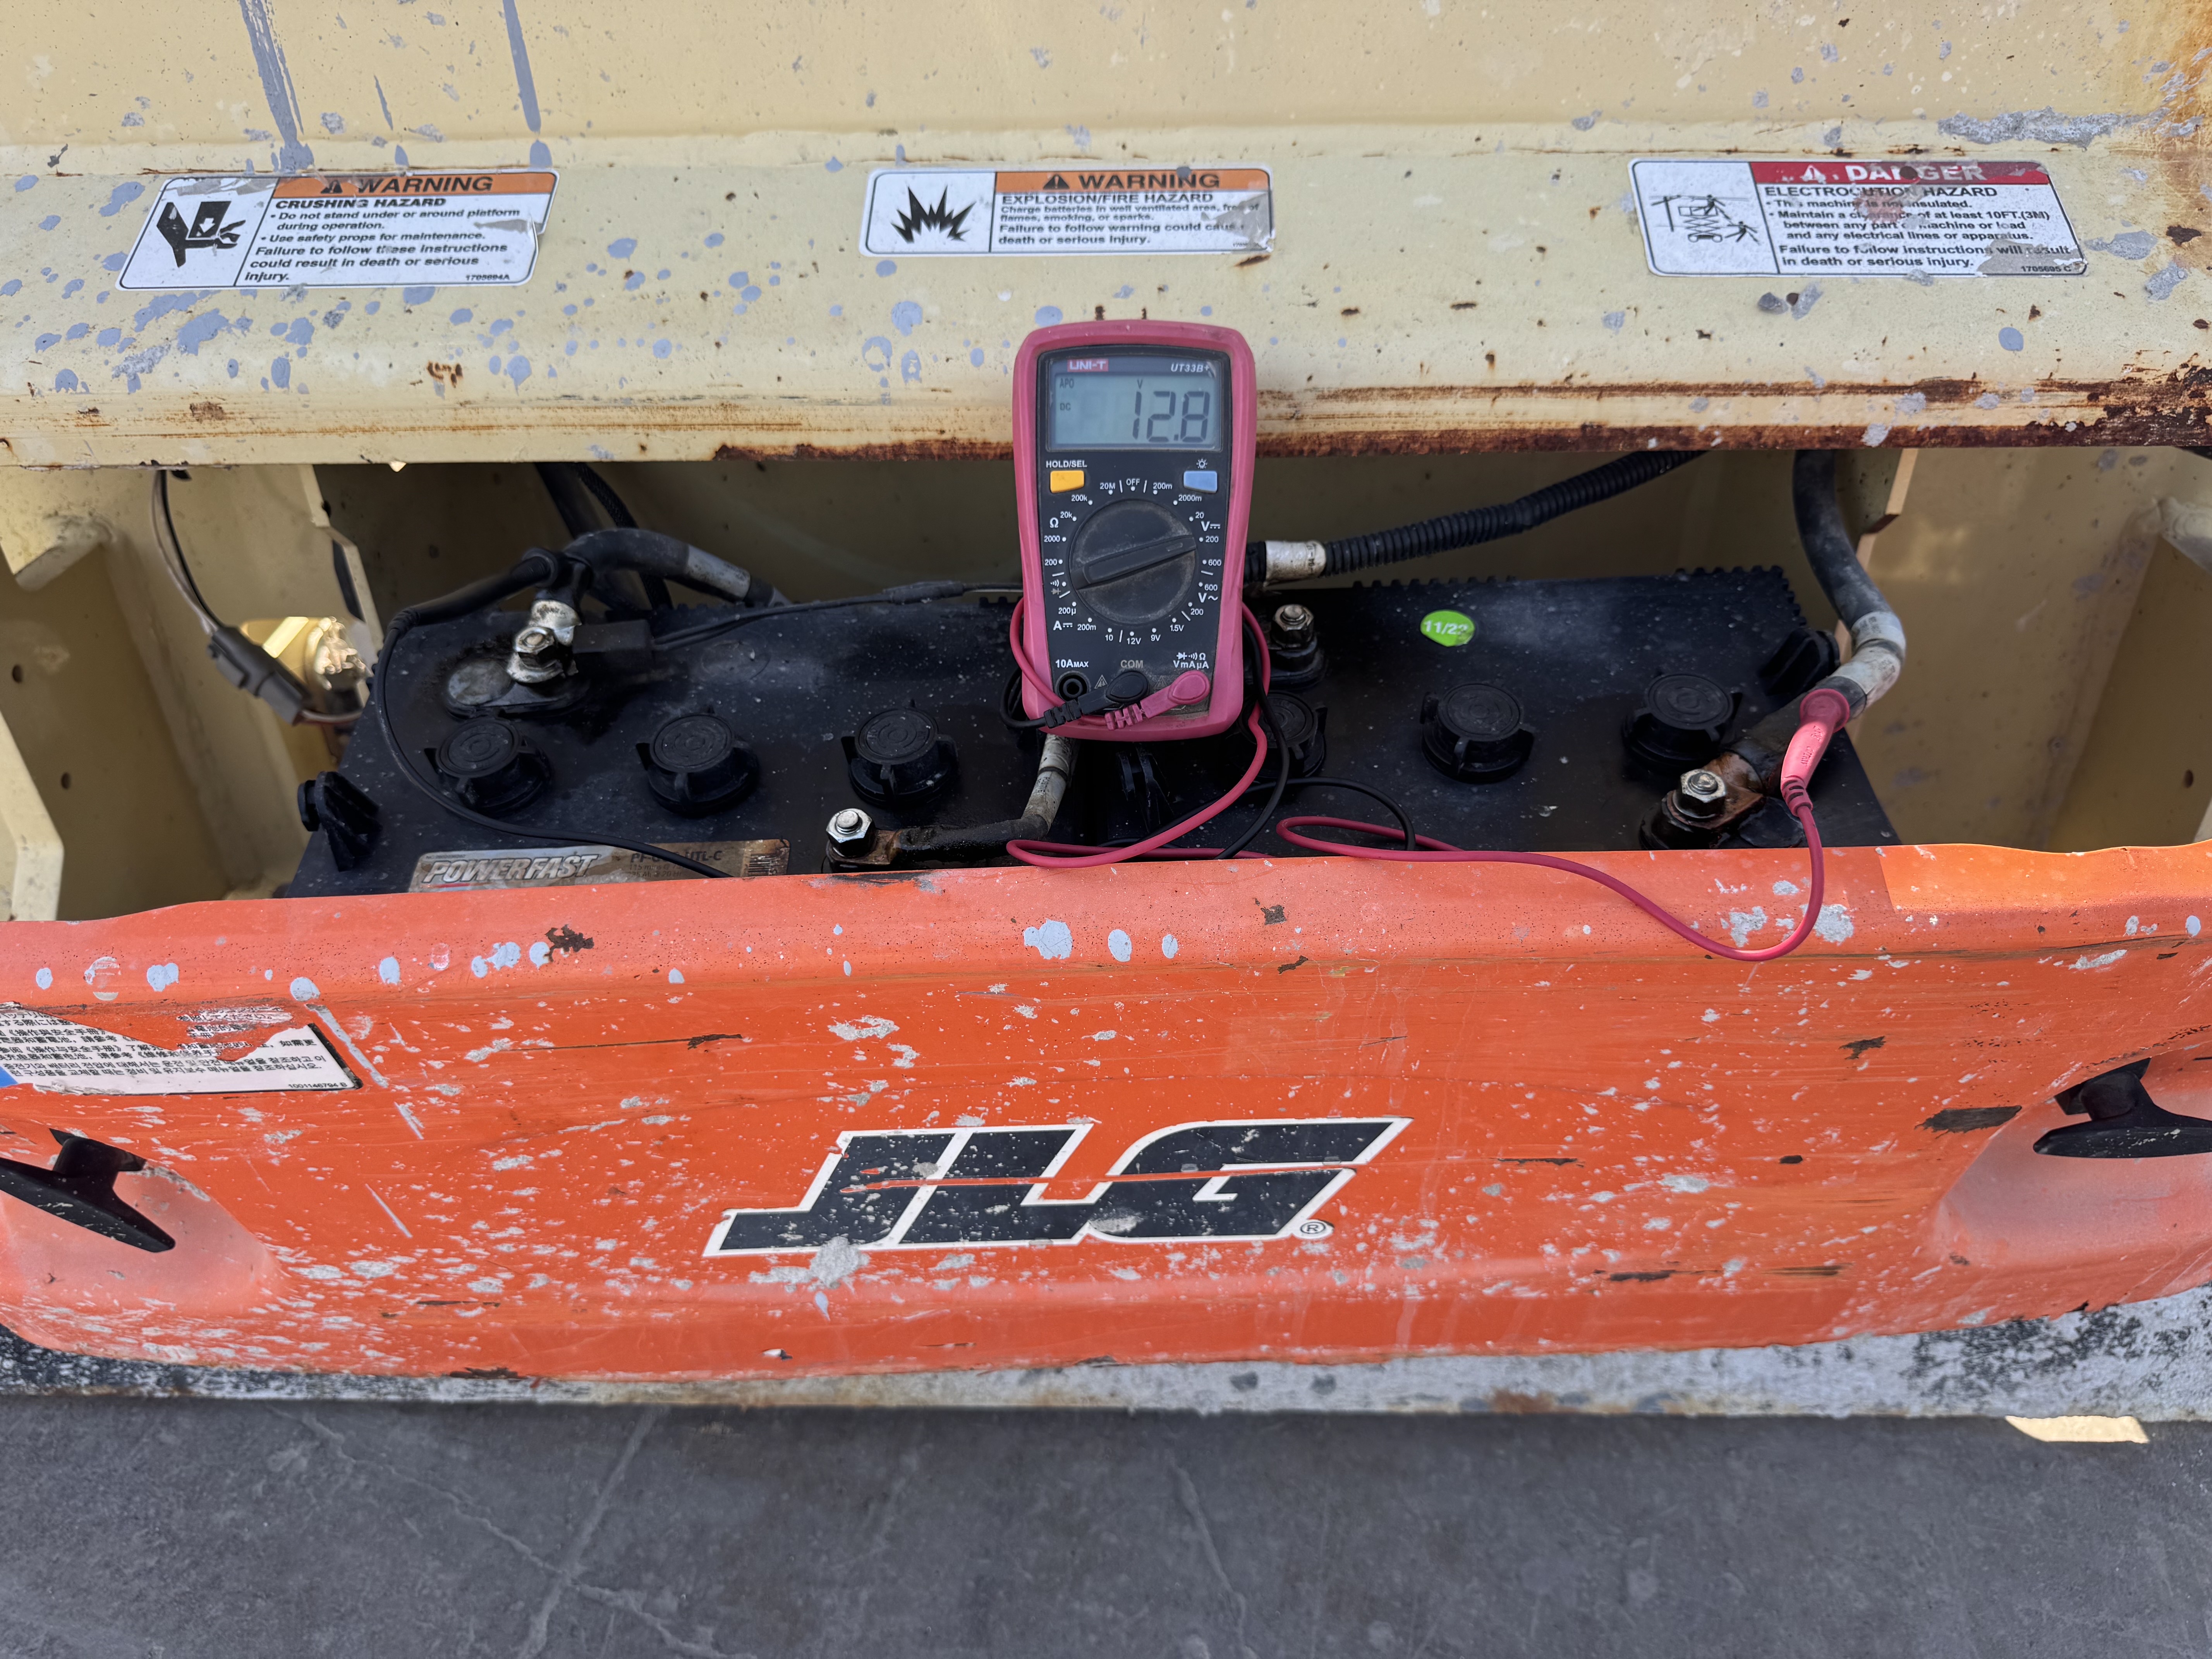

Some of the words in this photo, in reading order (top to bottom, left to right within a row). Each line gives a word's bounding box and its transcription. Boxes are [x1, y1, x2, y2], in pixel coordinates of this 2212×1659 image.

[357, 177, 493, 193] WARNING
[1079, 174, 1219, 189] WARNING
[1923, 187, 1997, 197] HAZARD
[276, 199, 369, 210] CRUSHING
[374, 198, 446, 208] HAZARD
[1002, 194, 1139, 204] EXPLOSION/FIRE
[1145, 194, 1213, 203] HAZARD
[419, 210, 464, 218] around
[467, 209, 520, 218] platform
[1001, 206, 1041, 214] Charge
[1001, 214, 1041, 222] flames,
[1044, 214, 1095, 222] smoking,
[1113, 214, 1154, 222] sparks.
[1986, 211, 2050, 220] 10FT.(3M)
[277, 222, 318, 232] during
[321, 222, 385, 231] operation.
[1000, 225, 1044, 233] Failure
[1065, 224, 1105, 232] follow
[1108, 223, 1160, 233] warning
[1165, 223, 1200, 231] could
[1843, 222, 1867, 230] any
[1871, 221, 1898, 230] part
[297, 234, 335, 244] safety
[338, 234, 376, 243] props
[999, 236, 1035, 244] death
[1057, 236, 1105, 244] serious
[1109, 235, 1150, 245] injury.
[1962, 232, 2033, 240] apparatus.
[255, 247, 306, 256] Failure
[309, 247, 324, 255] to
[328, 246, 372, 255] follow
[420, 244, 508, 253] instructions
[1779, 245, 1831, 254] Failure
[1835, 246, 1850, 254] to
[1903, 245, 1993, 254] instructions
[1997, 245, 2023, 254] will
[250, 259, 295, 268] could
[295, 259, 338, 268] result
[341, 259, 355, 267] in
[359, 258, 400, 267] death
[424, 256, 479, 265] serious
[1782, 258, 1796, 266] in
[1801, 257, 1842, 266] death
[1867, 257, 1923, 266] serious
[1927, 257, 1974, 268] injury.
[244, 272, 289, 282] injury.
[1069, 360, 1106, 370] UNI-T
[1060, 379, 1074, 388] APO
[1137, 379, 1143, 389] V
[1060, 403, 1071, 411] DC
[1133, 391, 1210, 443] 12.8
[1120, 660, 1144, 668] COM
[422, 853, 599, 883] POWERFAST
[702, 1117, 1413, 1256] JLG
